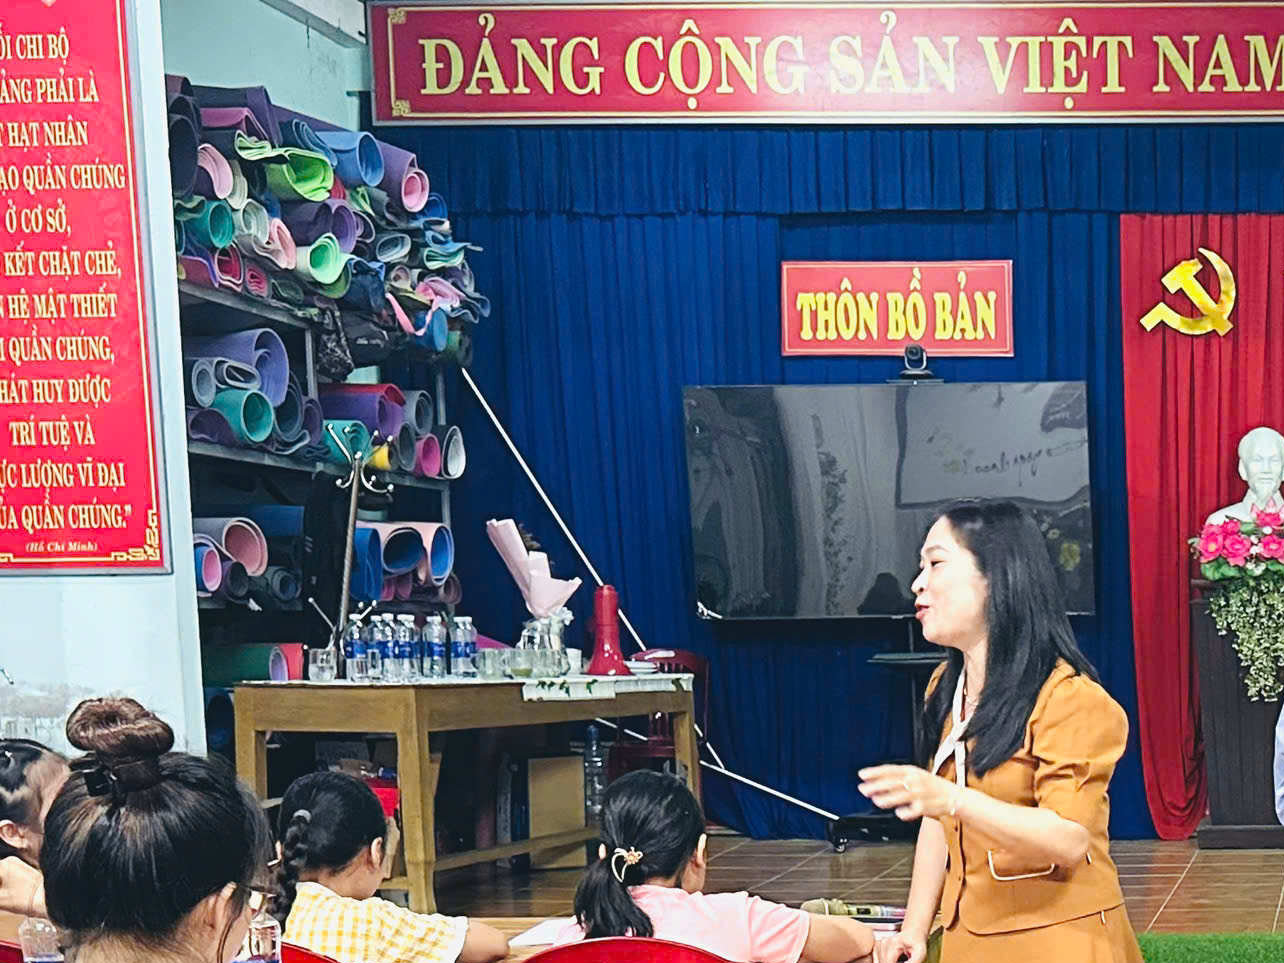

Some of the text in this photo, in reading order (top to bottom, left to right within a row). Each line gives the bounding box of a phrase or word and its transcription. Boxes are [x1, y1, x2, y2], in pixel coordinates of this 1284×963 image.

[16, 34, 44, 60] CHI
[47, 26, 69, 65] BỘ
[418, 15, 604, 96] ĐẢNG
[624, 19, 806, 110] CỘNG
[828, 11, 957, 96] SẢN
[977, 18, 1134, 110] VIỆT
[36, 67, 75, 103] PHẢI
[78, 70, 100, 102] LÀ
[8, 121, 39, 152] HẠT
[43, 114, 88, 146] NHÂN
[23, 153, 66, 195] QUẦN
[70, 157, 126, 190] CHÚNG
[5, 198, 71, 237] Ở CƠ SỞ,
[4, 240, 121, 281] KẾT CHẶT CHẺ,
[7, 287, 30, 325] HỆ
[34, 287, 67, 325] MẬT
[70, 282, 118, 318] THIẾT
[796, 267, 997, 342] THÔN BỒ BẢN
[9, 324, 52, 366] QUẦN
[56, 329, 115, 364] CHÚNG,
[32, 379, 64, 404] HUY
[68, 373, 111, 408] ĐƯỢC
[9, 414, 96, 451] TRÍ TUỆ VÀ
[20, 458, 74, 492] LƯỢNG
[77, 457, 95, 488] VĨ
[97, 462, 126, 492] ĐẠI
[22, 492, 65, 534] QUẦN
[47, 541, 65, 552] Chí
[68, 541, 98, 552] Minh)
